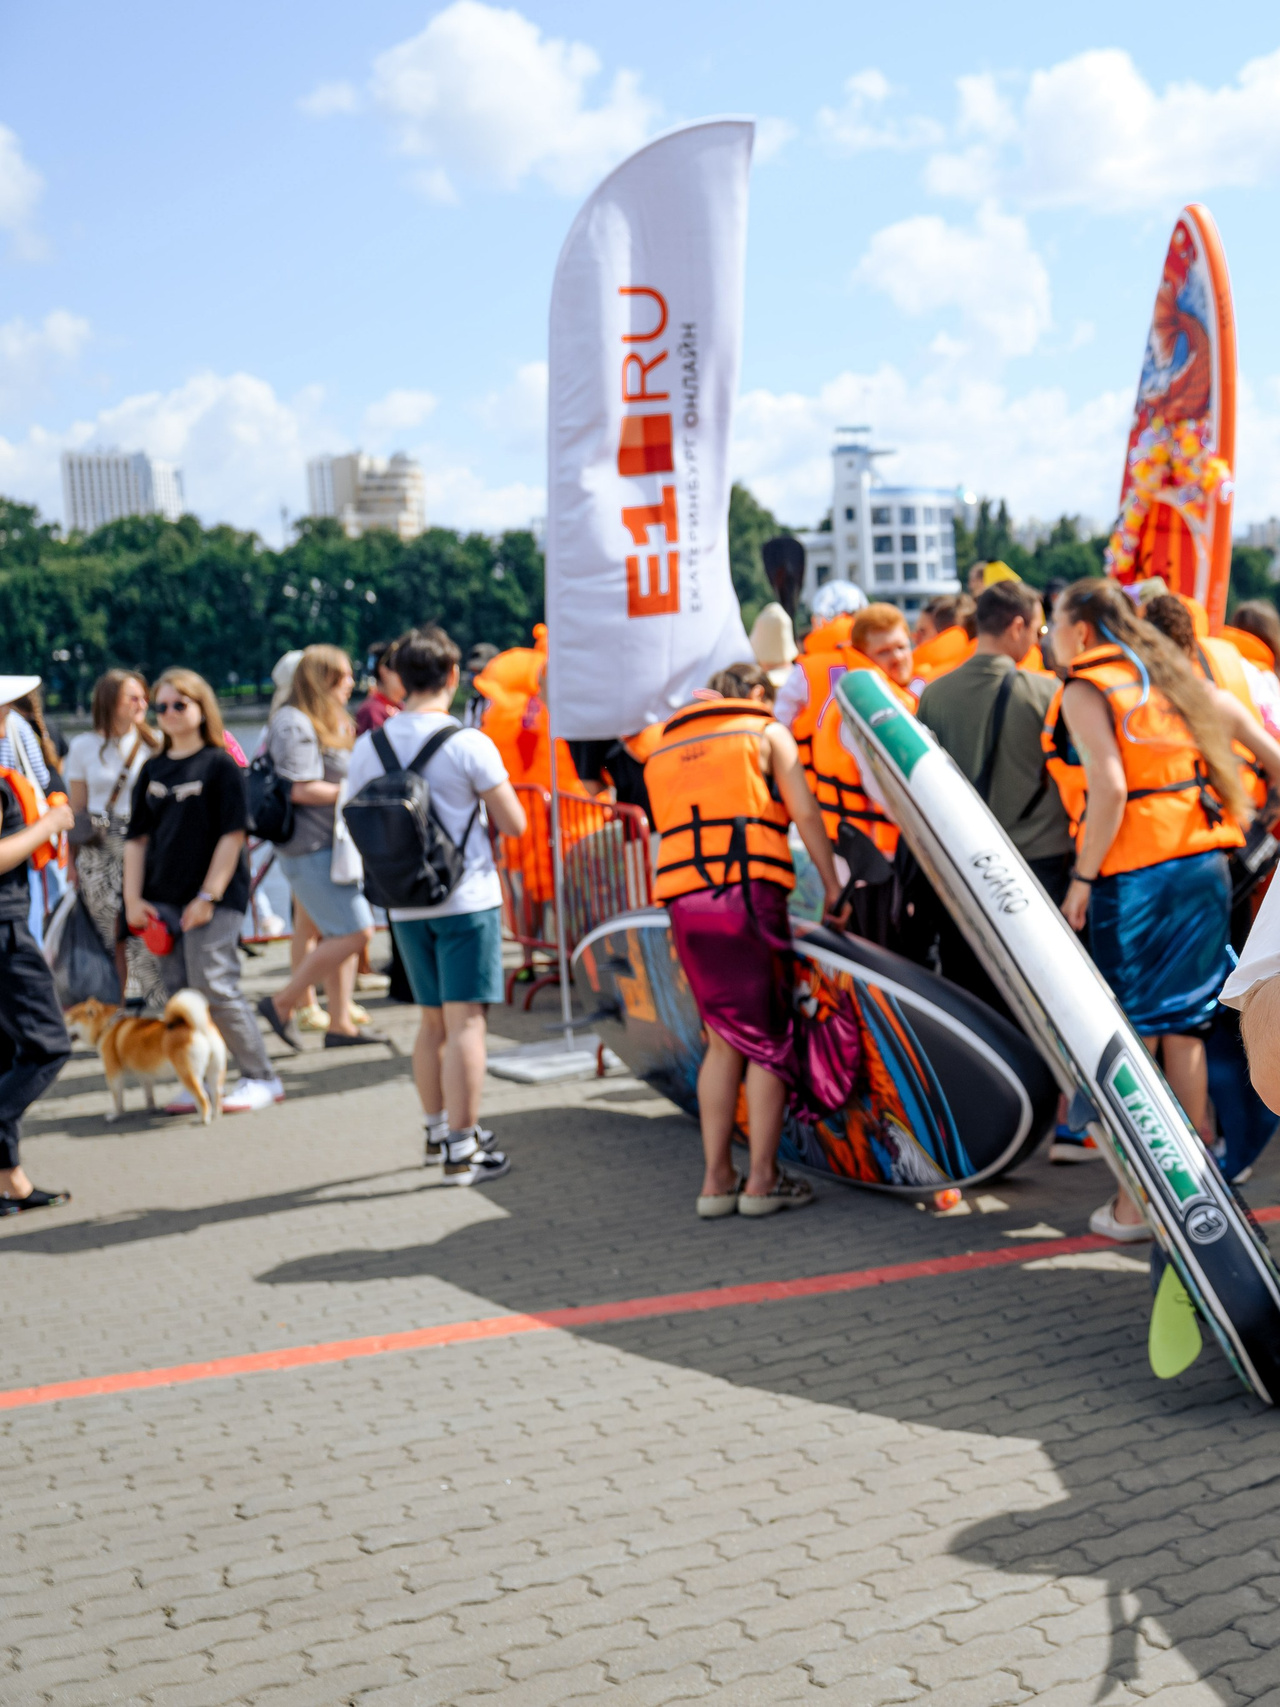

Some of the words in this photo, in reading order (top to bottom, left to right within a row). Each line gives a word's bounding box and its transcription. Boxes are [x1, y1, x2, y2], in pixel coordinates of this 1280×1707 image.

[617, 285, 670, 404] RU
[677, 321, 699, 429] ОНЛАЙН
[621, 484, 681, 619] E1
